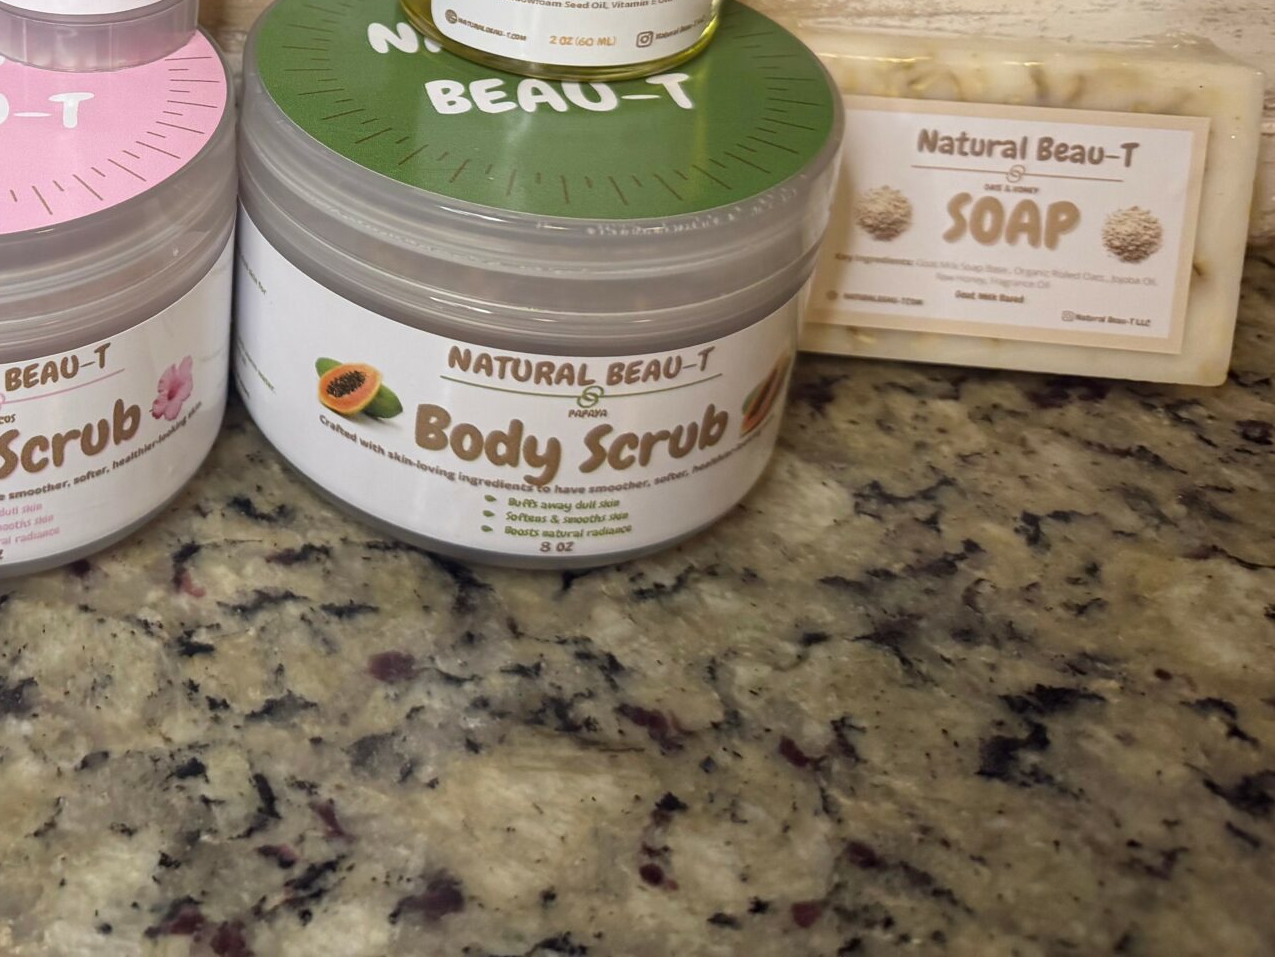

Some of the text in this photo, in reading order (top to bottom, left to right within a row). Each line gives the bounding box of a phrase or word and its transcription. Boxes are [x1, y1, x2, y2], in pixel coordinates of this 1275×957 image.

[564, 0, 590, 10] Seed
[549, 35, 556, 45] 2
[559, 36, 574, 46] OZ
[575, 35, 594, 47] (60
[425, 73, 695, 117] BEAU-T
[917, 127, 1140, 168] Natural Beau-T
[942, 191, 1082, 251] SOAP
[5, 342, 111, 392] BEAU-T
[448, 345, 715, 386] NATURAL BEAU-T
[568, 408, 608, 418] PAPAYA
[319, 414, 358, 444] Crafted
[359, 437, 385, 456] with
[388, 449, 456, 481] skin-loving
[458, 472, 534, 493] ingredients
[537, 483, 551, 493] to
[554, 484, 586, 494] have
[588, 479, 651, 494] smoother,
[415, 403, 729, 487] Body Scrub
[8, 479, 71, 501] smoother,
[550, 514, 560, 524] &
[540, 541, 574, 554] 8 OZ
